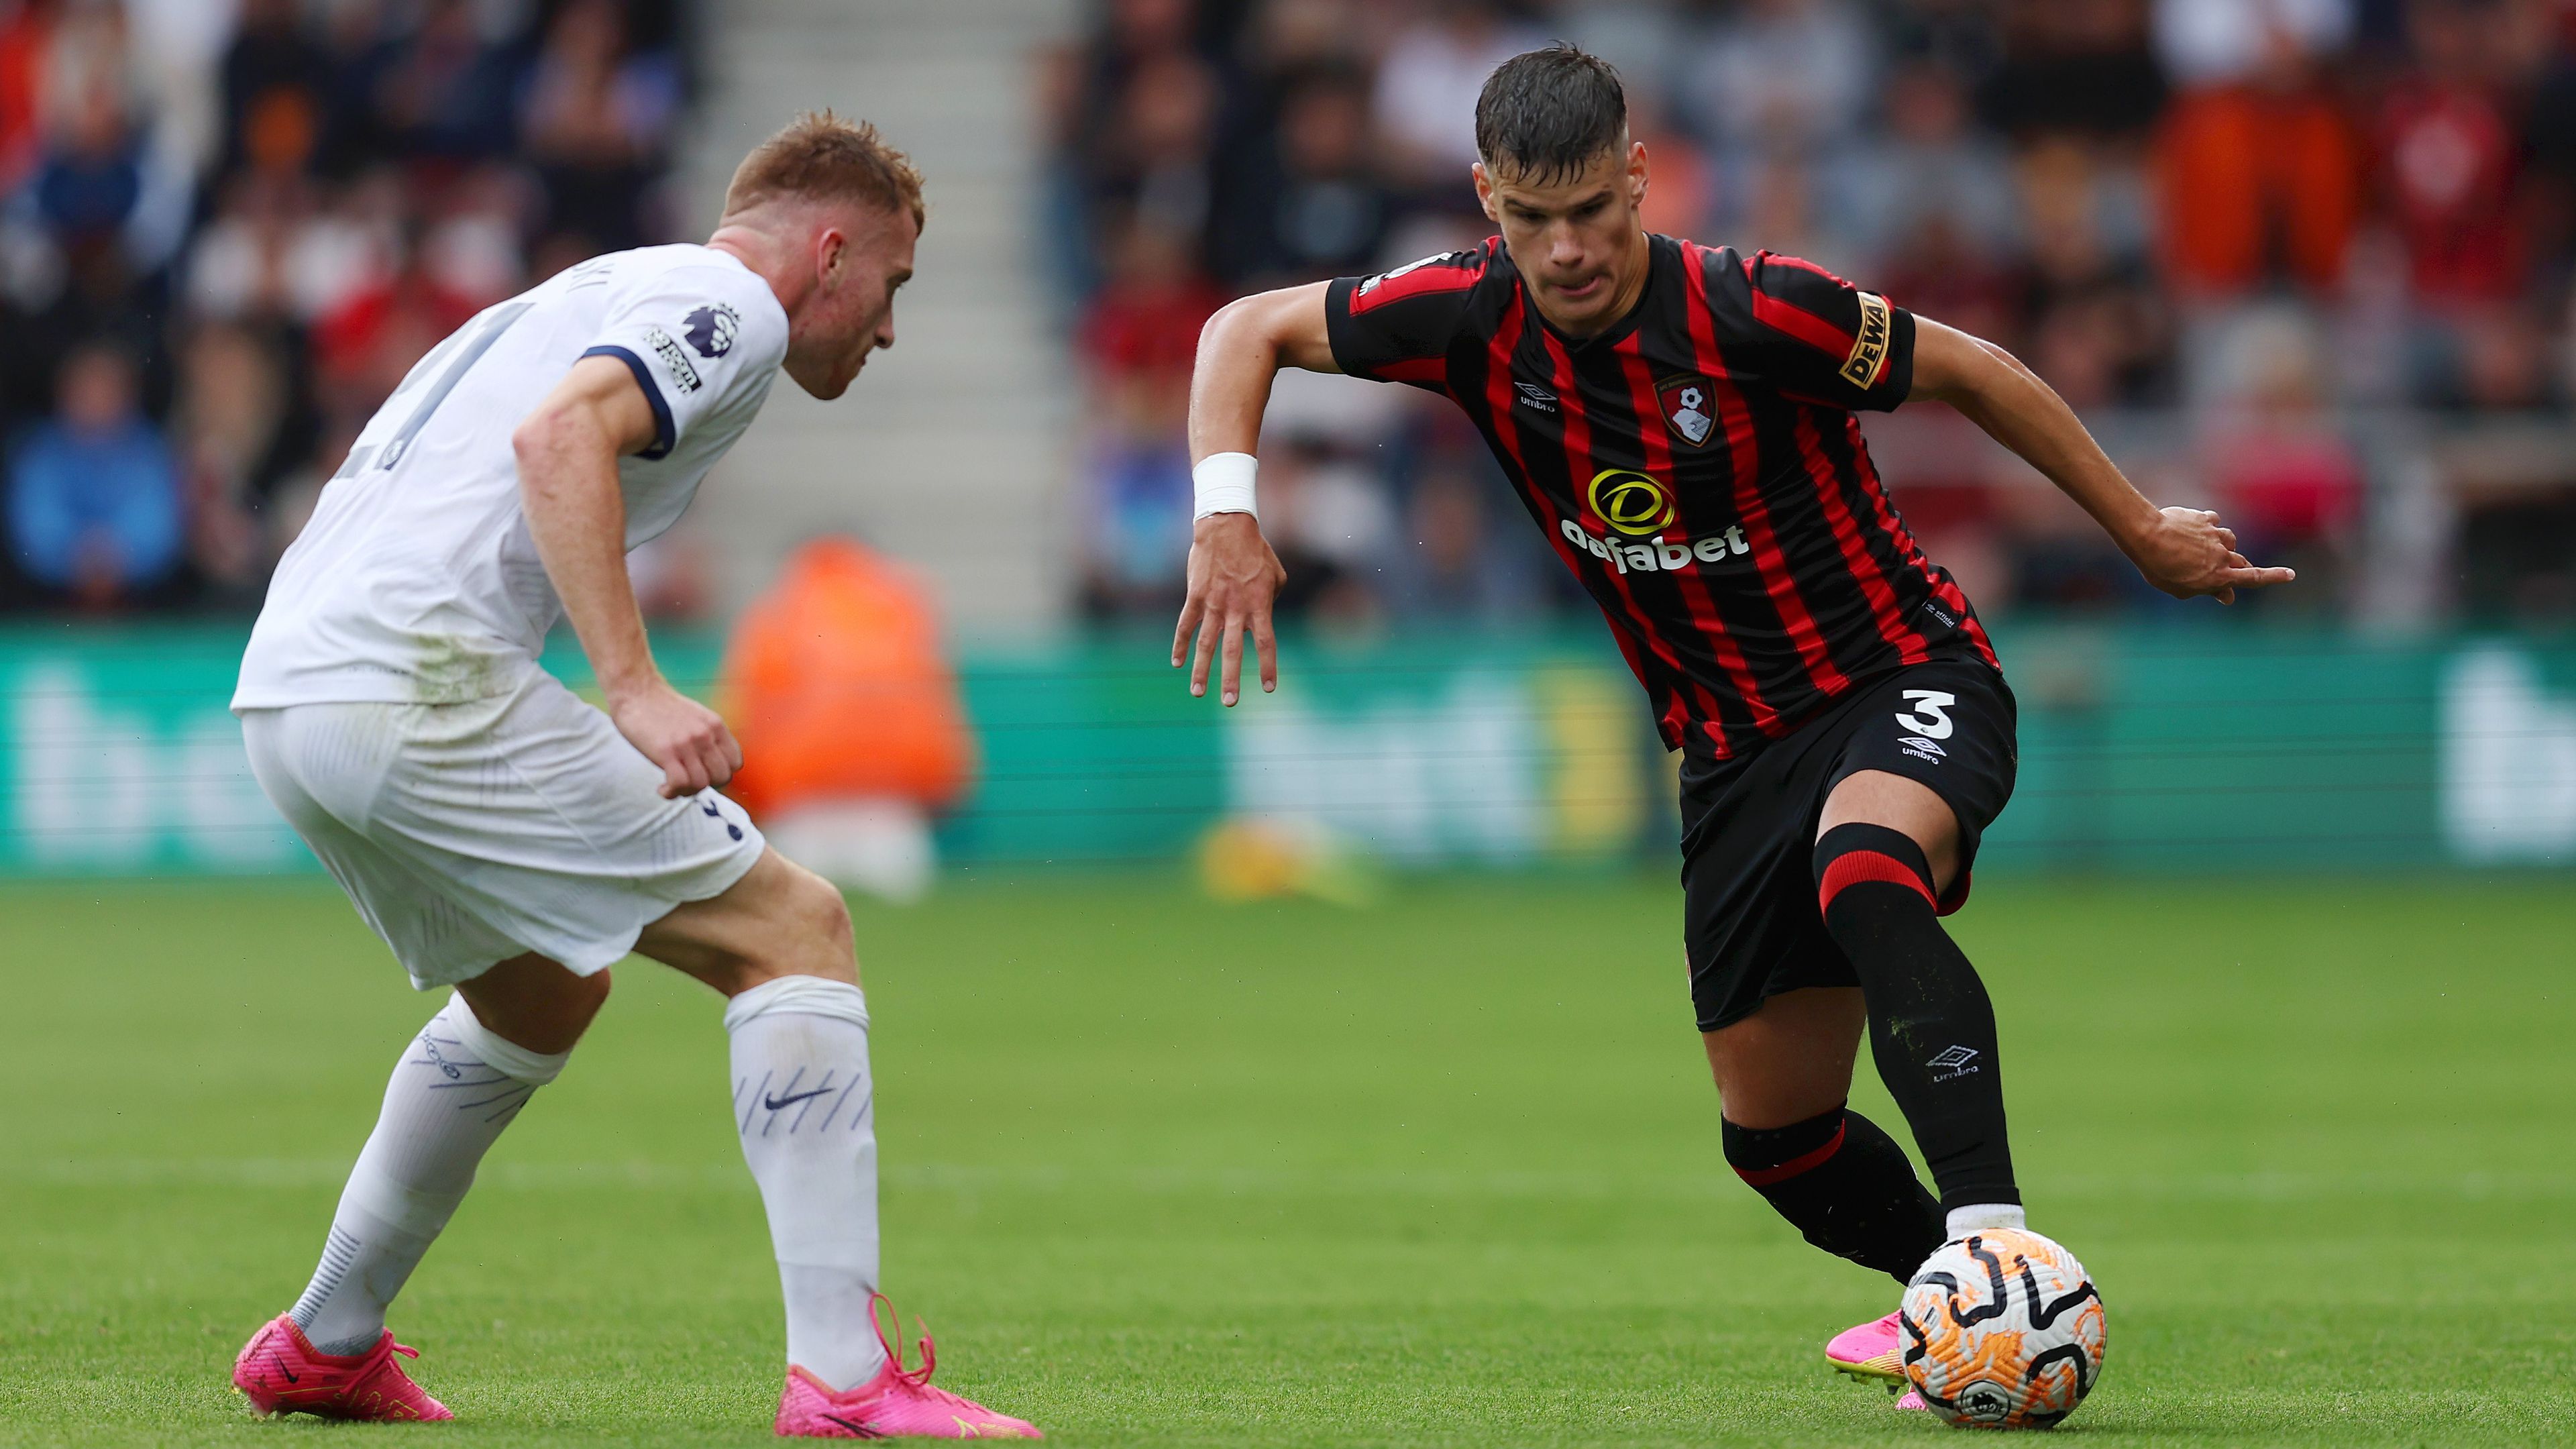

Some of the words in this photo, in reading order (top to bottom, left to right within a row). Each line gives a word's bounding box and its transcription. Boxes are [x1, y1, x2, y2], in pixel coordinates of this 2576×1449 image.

[1847, 305, 1884, 384] DEWA
[1520, 396, 1556, 413] umbro
[1895, 690, 1955, 739] 3
[1902, 747, 1939, 765] umbro
[1933, 1066, 1978, 1081] umbro
